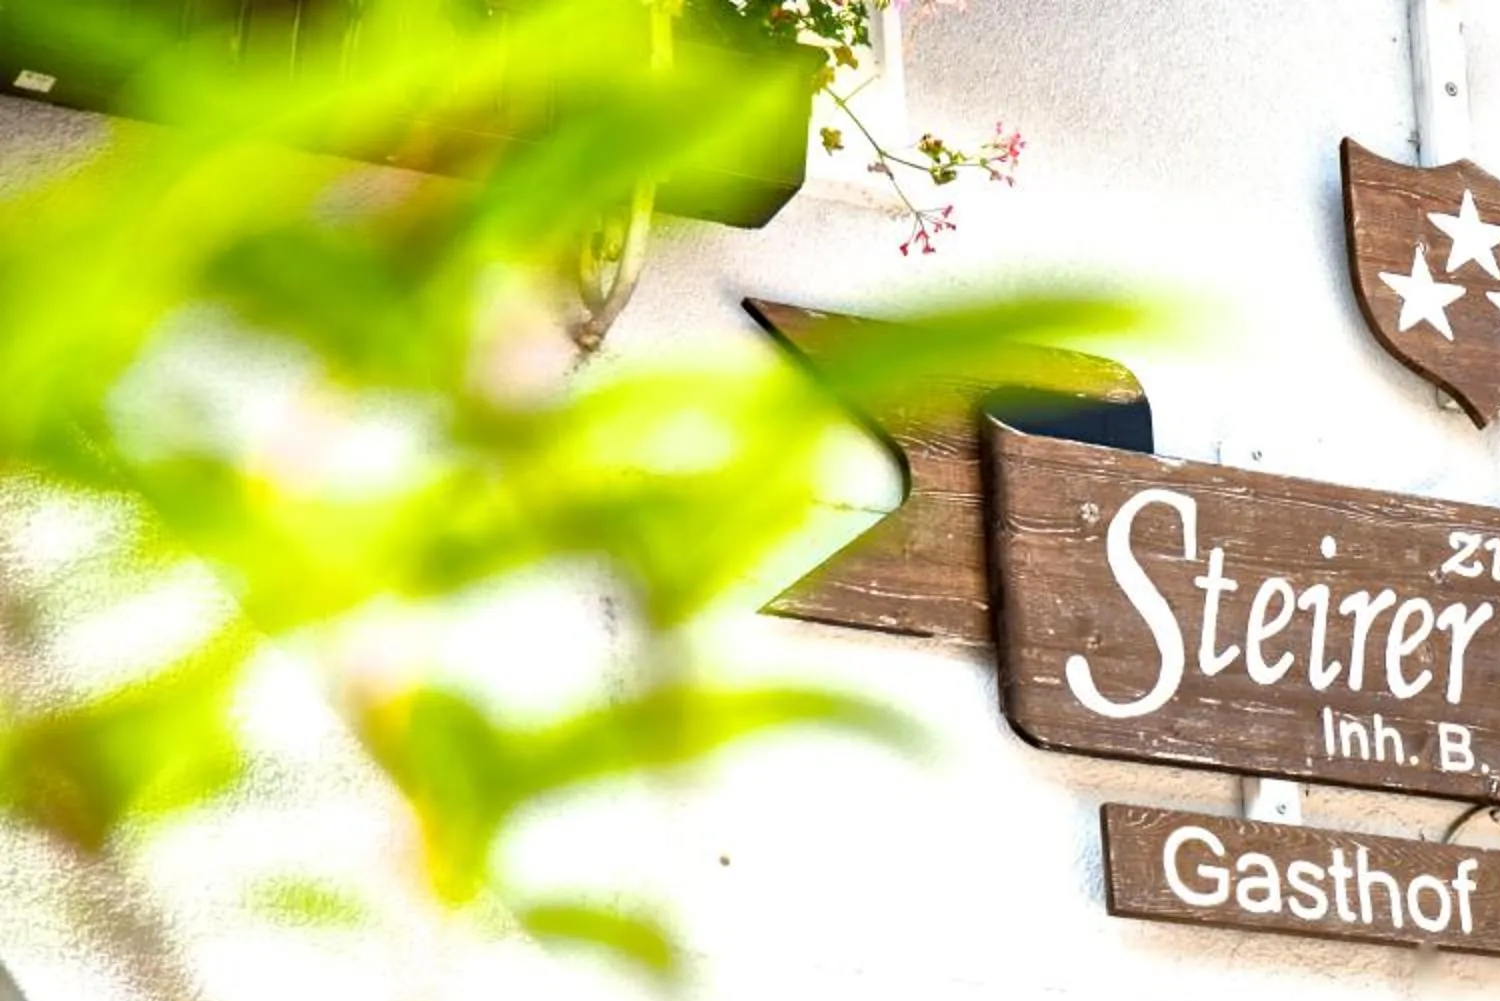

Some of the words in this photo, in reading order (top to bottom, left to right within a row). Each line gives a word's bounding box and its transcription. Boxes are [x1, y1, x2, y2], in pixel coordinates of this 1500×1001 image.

[1065, 488, 1494, 719] Steirer
[1323, 706, 1420, 766] Inh.
[1437, 722, 1490, 775] B.
[1162, 825, 1479, 934] Gasthof
